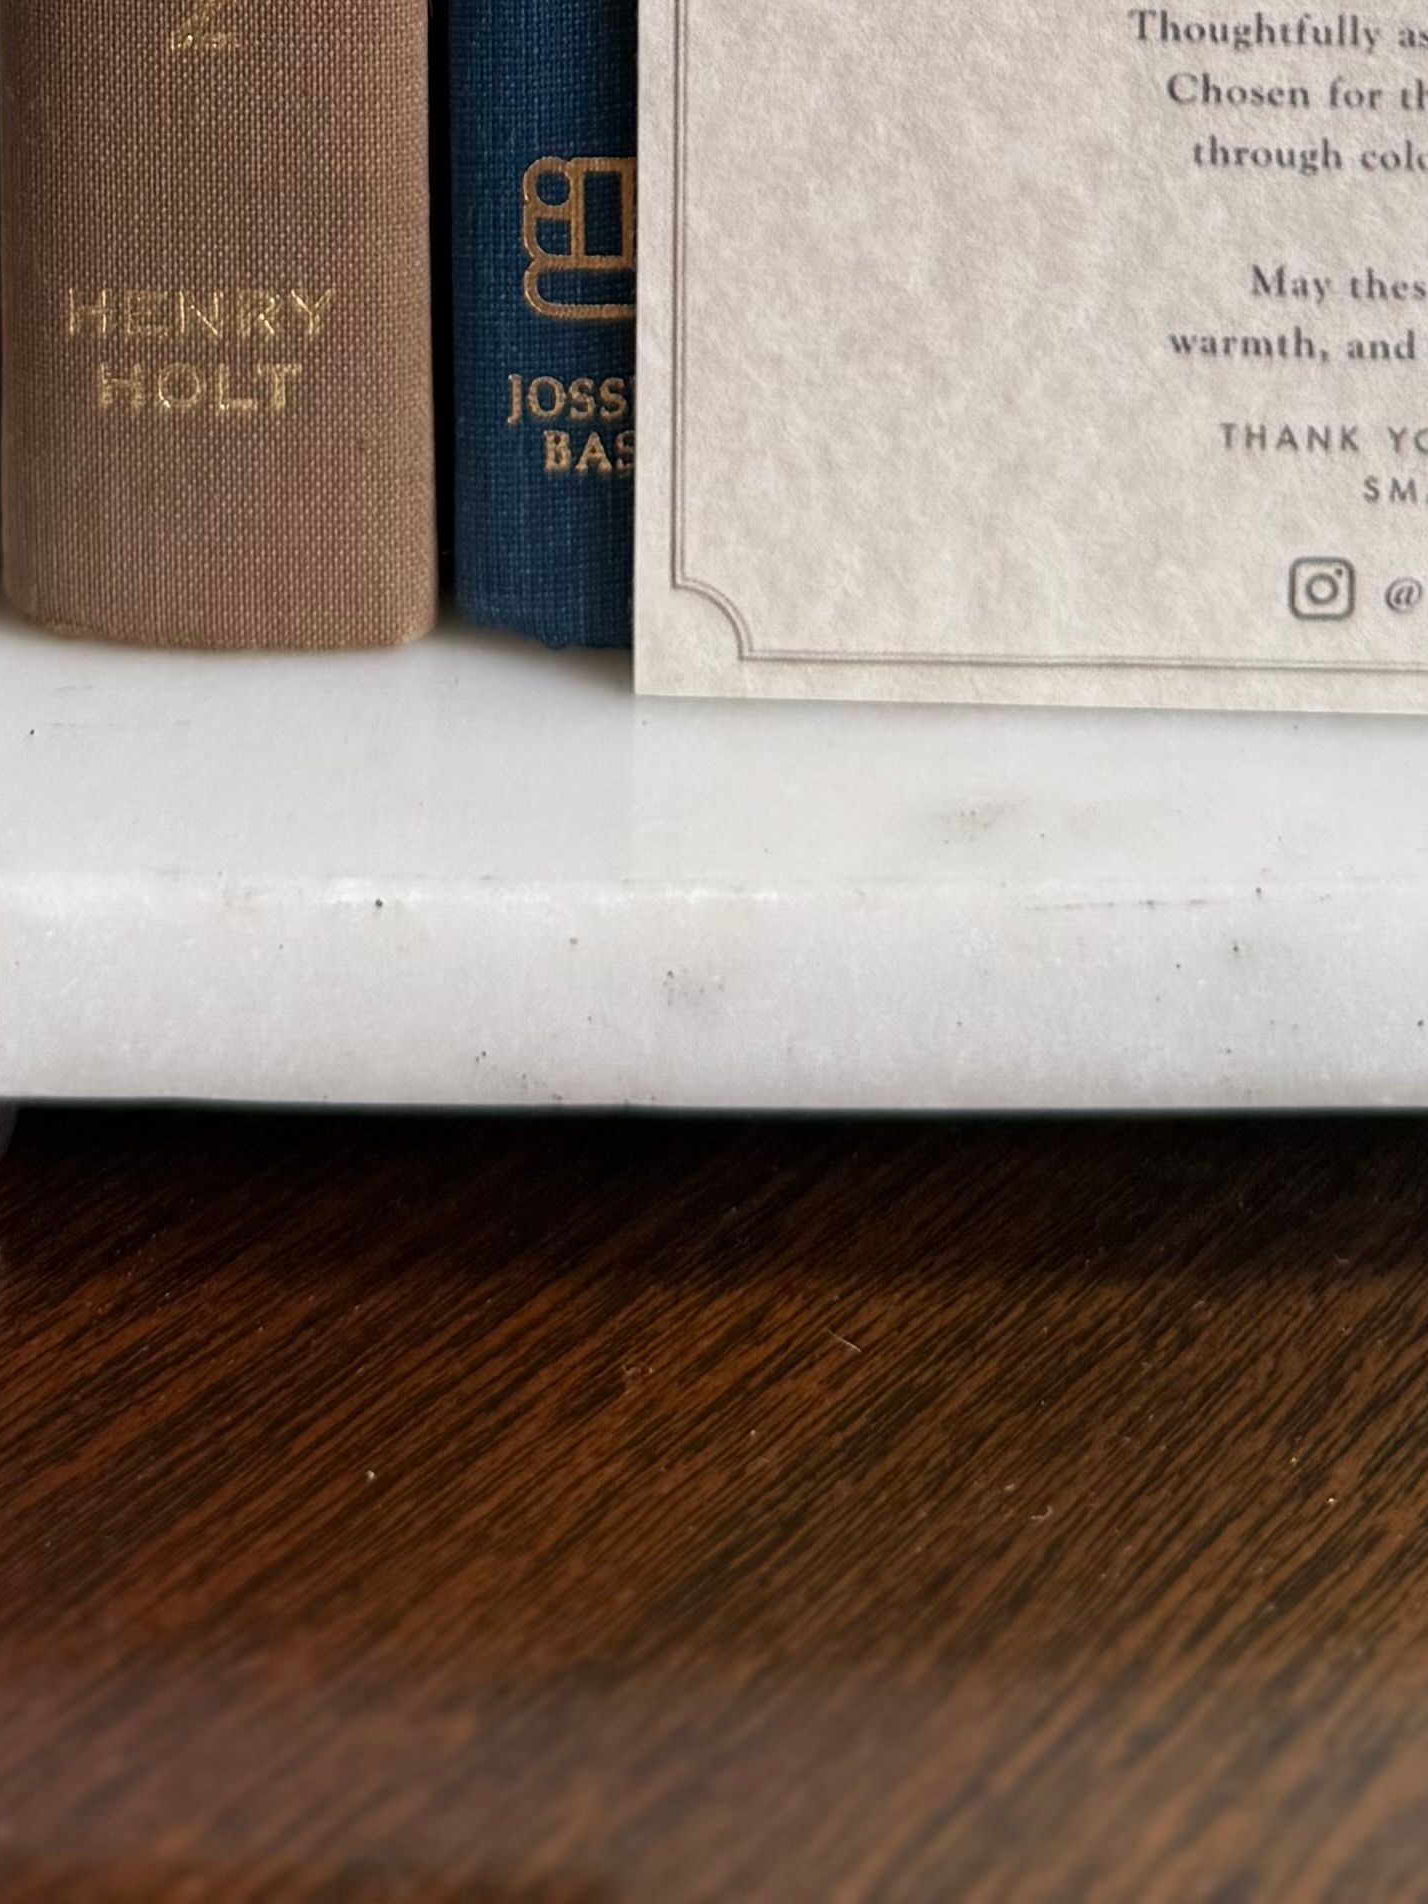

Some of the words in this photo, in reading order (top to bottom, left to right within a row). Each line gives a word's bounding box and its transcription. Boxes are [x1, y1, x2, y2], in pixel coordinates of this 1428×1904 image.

[1127, 8, 1381, 55] Thoughtfully
[1165, 70, 1311, 110] Chosen
[1328, 75, 1384, 111] for
[1192, 133, 1344, 179] through
[1250, 263, 1332, 306] May
[64, 286, 338, 339] HENRY
[1167, 324, 1331, 366] warmth,
[1346, 328, 1417, 363] and
[96, 360, 304, 415] HOLT
[507, 373, 630, 426] JOSS
[542, 430, 636, 474] BAS
[1219, 421, 1361, 455] THANK
